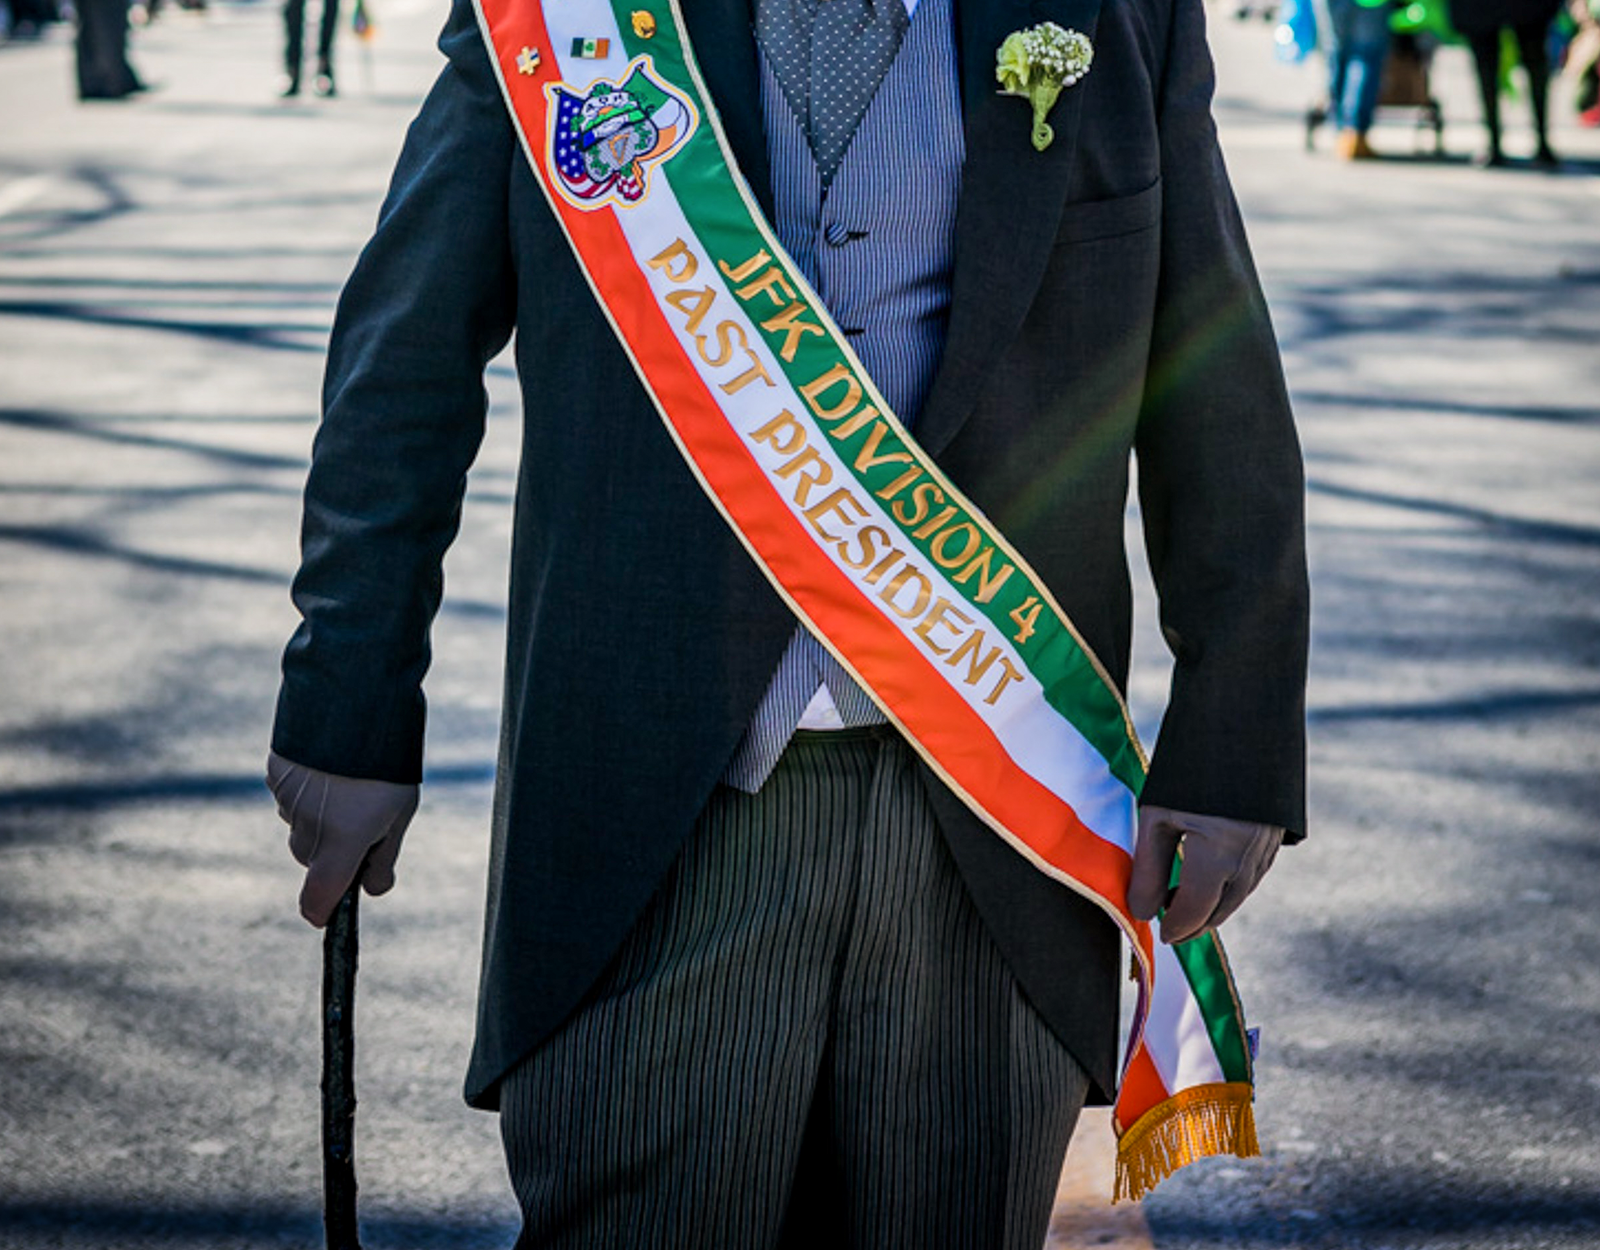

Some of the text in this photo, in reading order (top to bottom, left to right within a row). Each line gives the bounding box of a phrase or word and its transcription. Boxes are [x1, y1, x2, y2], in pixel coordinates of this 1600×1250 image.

[647, 238, 1024, 705] PAST PRESIDENT
[718, 249, 1043, 644] JFK DIVISION 4
